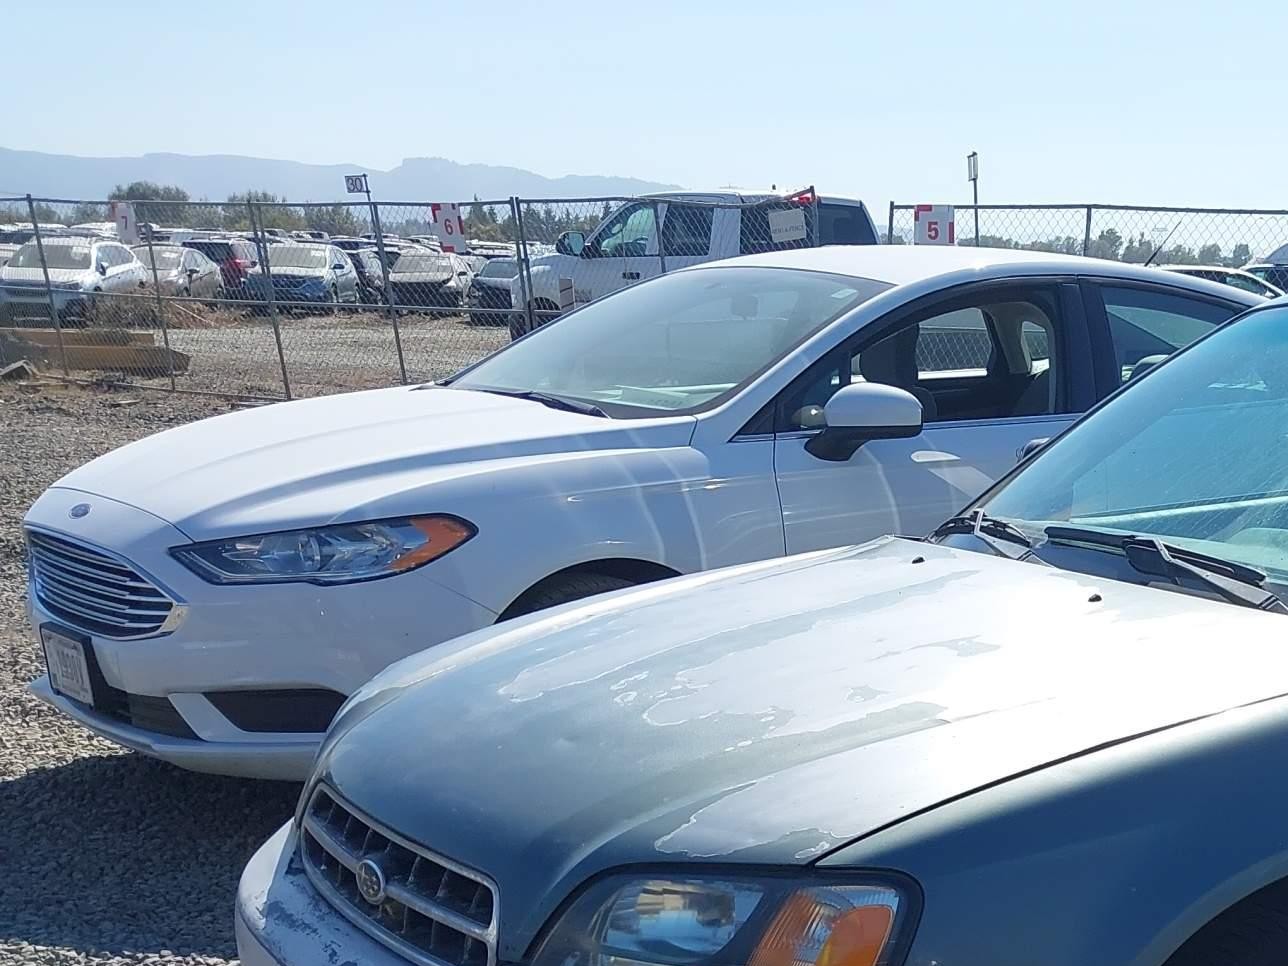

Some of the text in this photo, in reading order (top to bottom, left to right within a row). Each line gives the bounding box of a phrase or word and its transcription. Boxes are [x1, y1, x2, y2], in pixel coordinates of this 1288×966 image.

[346, 177, 363, 192] 30
[444, 218, 453, 235] 6
[927, 221, 939, 240] 5
